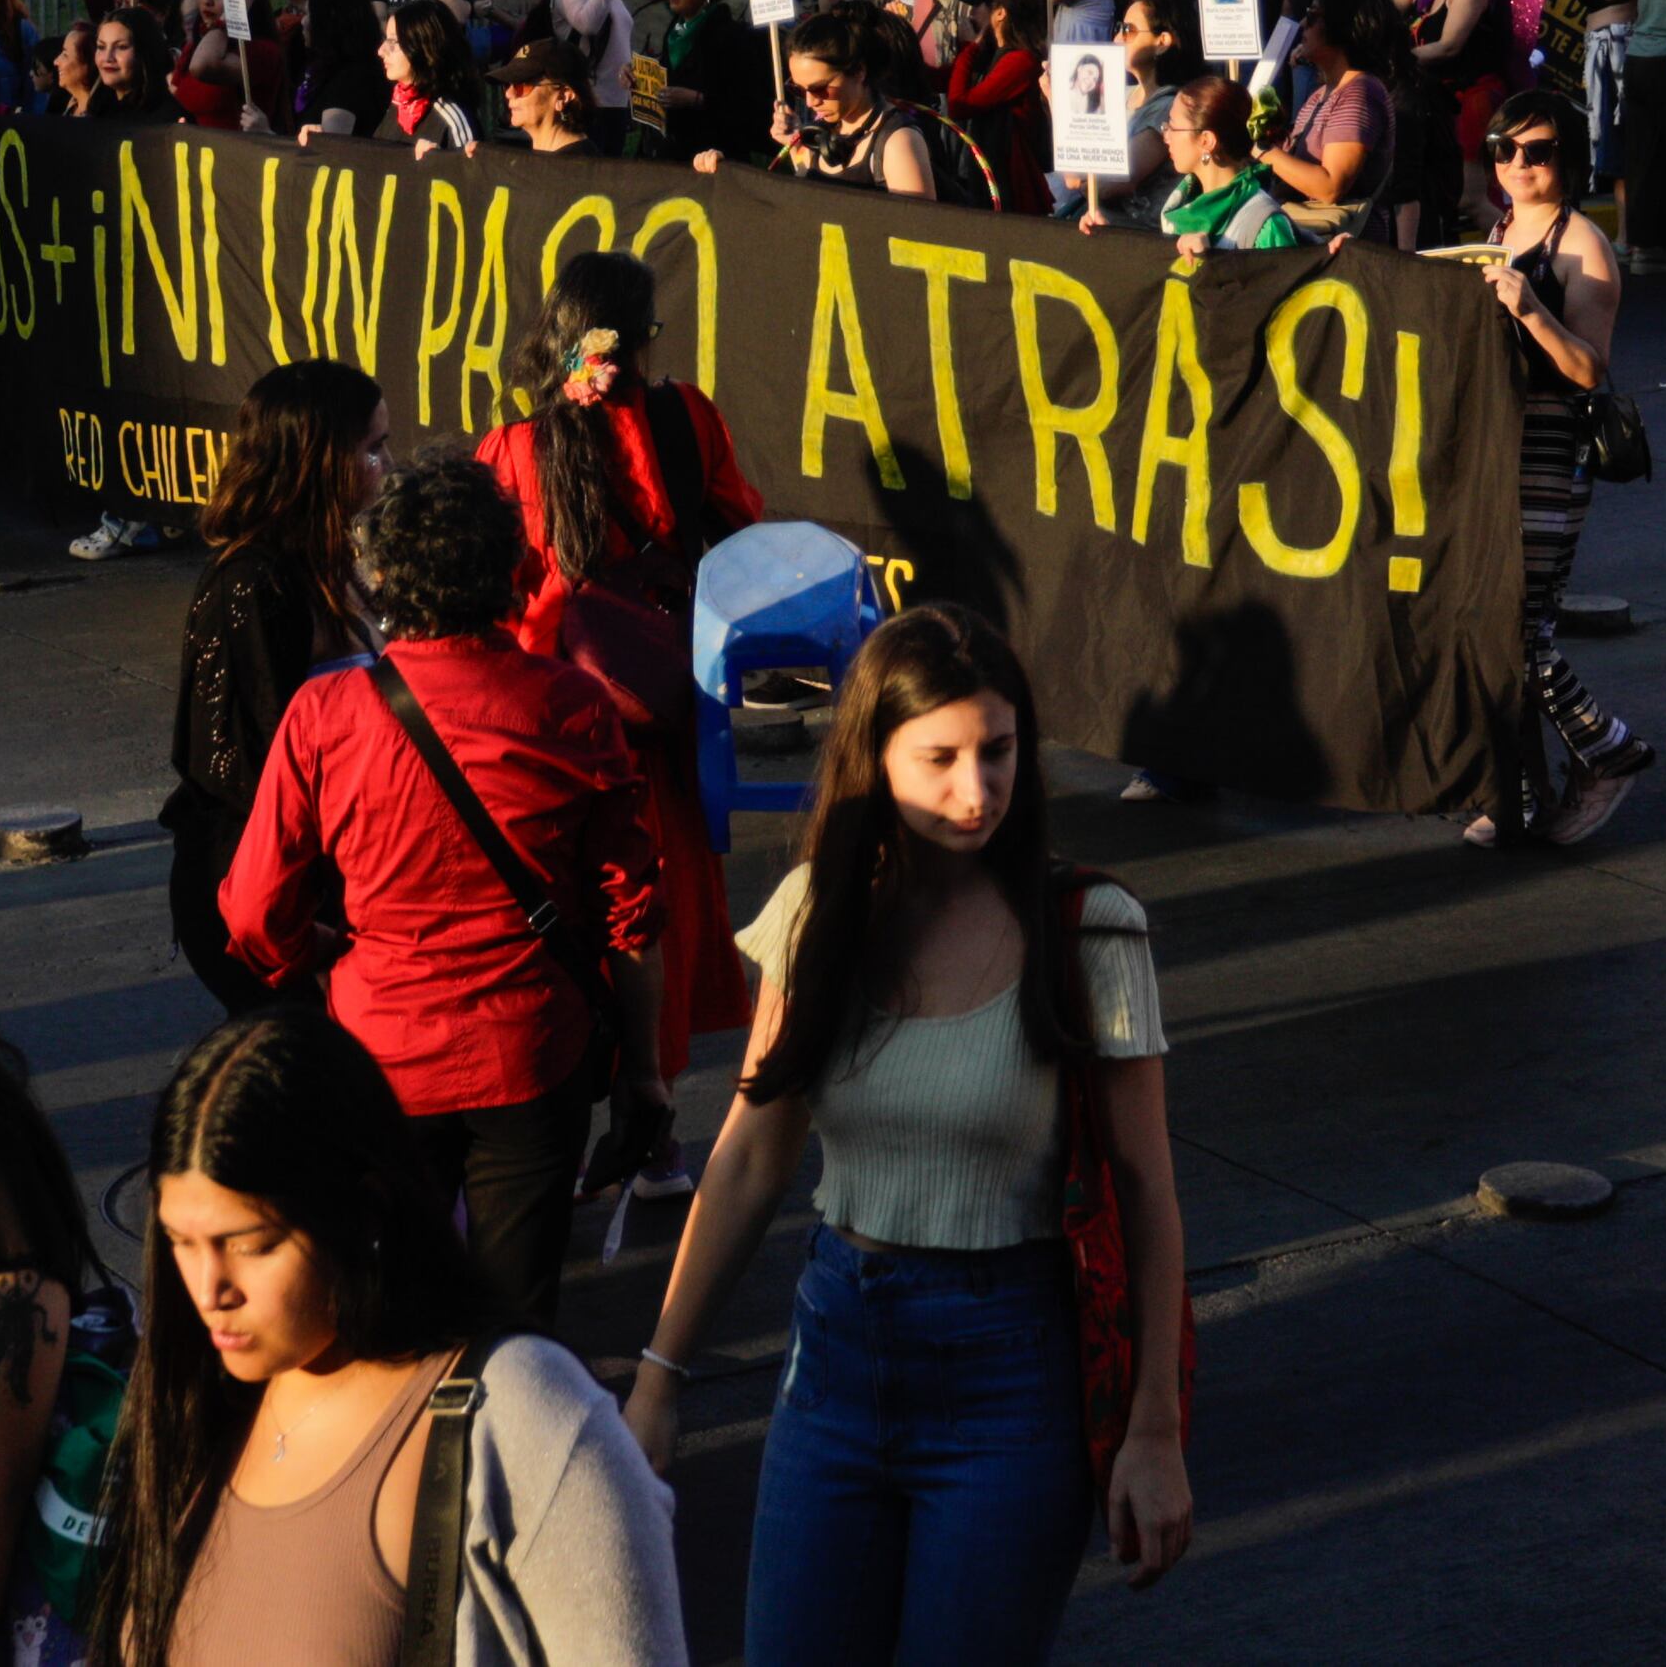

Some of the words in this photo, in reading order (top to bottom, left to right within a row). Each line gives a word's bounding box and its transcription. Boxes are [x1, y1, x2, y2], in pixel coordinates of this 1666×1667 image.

[59, 408, 105, 492] RED
[261, 157, 397, 378] UN
[801, 222, 1426, 593] ATRÁS!
